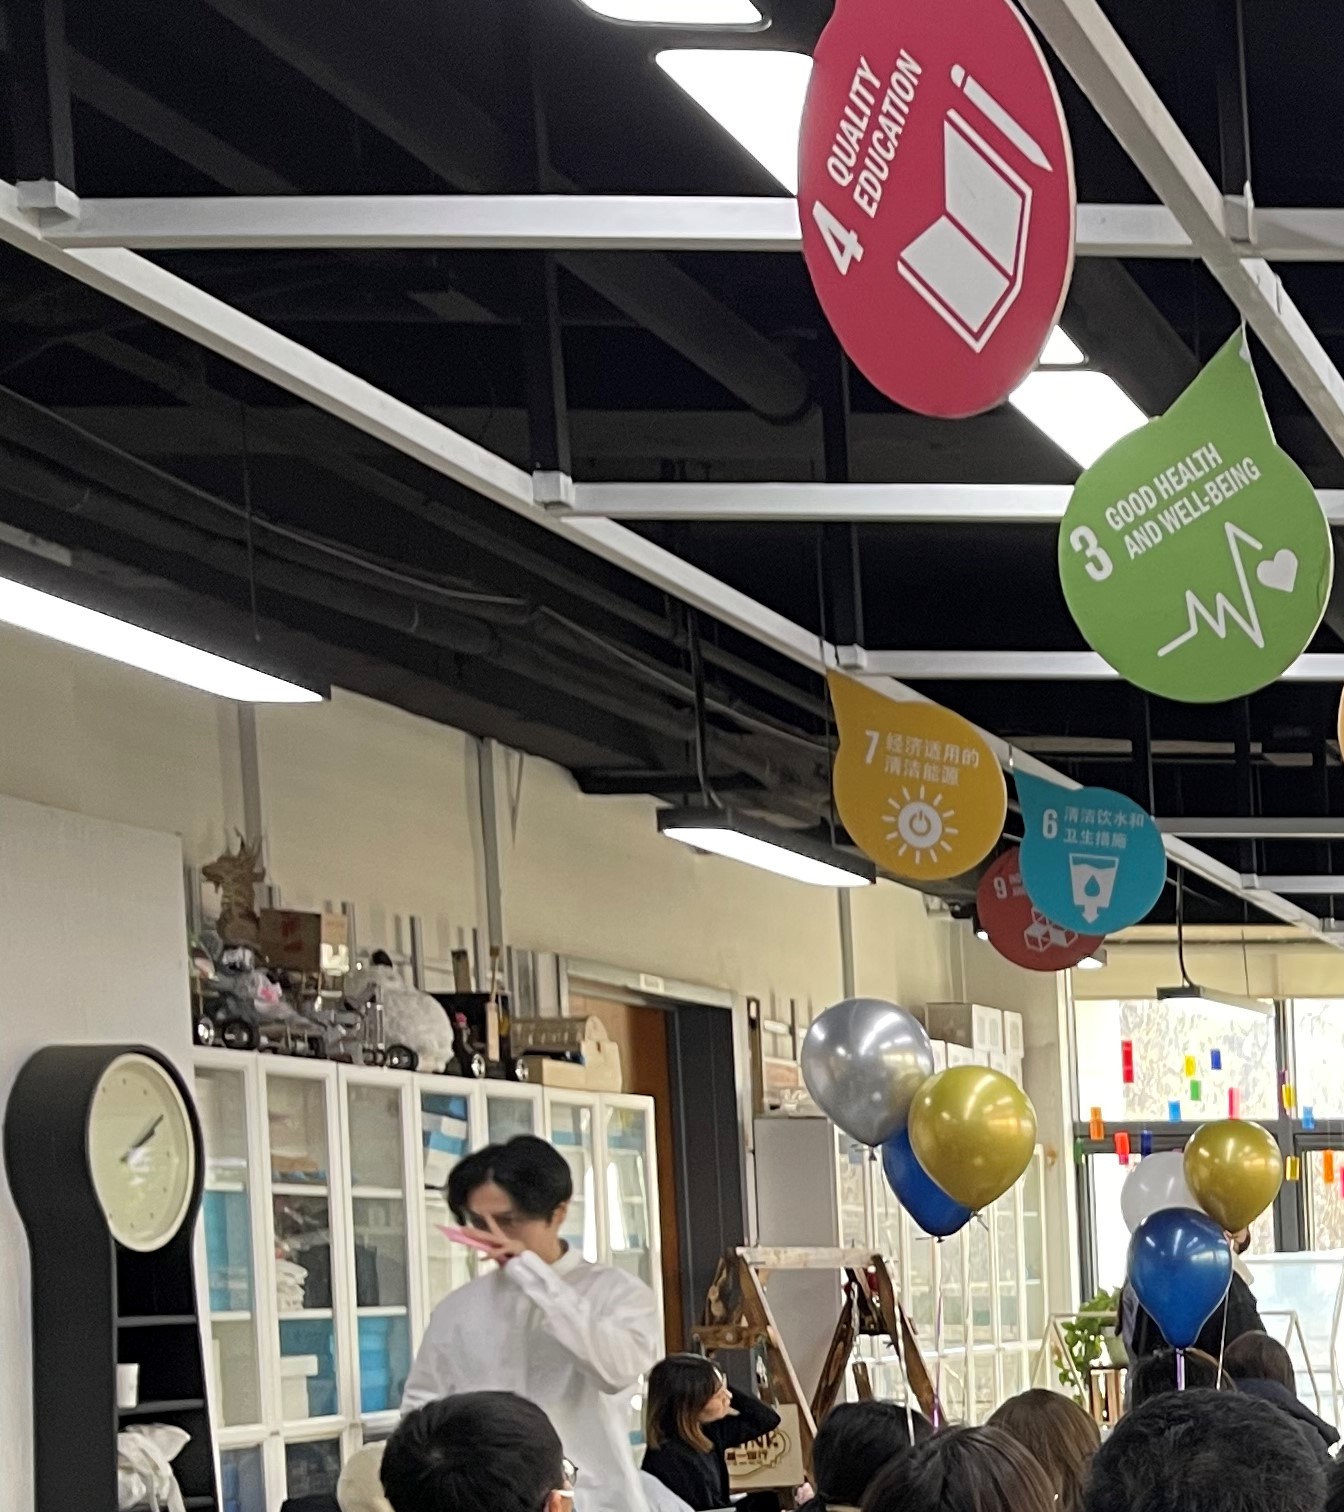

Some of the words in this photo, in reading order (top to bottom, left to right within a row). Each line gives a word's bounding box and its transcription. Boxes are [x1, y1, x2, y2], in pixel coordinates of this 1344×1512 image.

[827, 54, 881, 187] QUALITY
[853, 48, 922, 219] EDUCATION
[812, 200, 864, 276] 4
[1105, 485, 1158, 531] GOOD
[1153, 442, 1223, 500] HEALTH
[1123, 520, 1163, 560] AND
[1157, 457, 1262, 534] WELL-BEING
[1069, 525, 1113, 582] 3
[865, 729, 880, 764] 7
[884, 754, 960, 787] 清洁能源
[1042, 809, 1058, 839] 6
[993, 877, 1008, 899] 9
